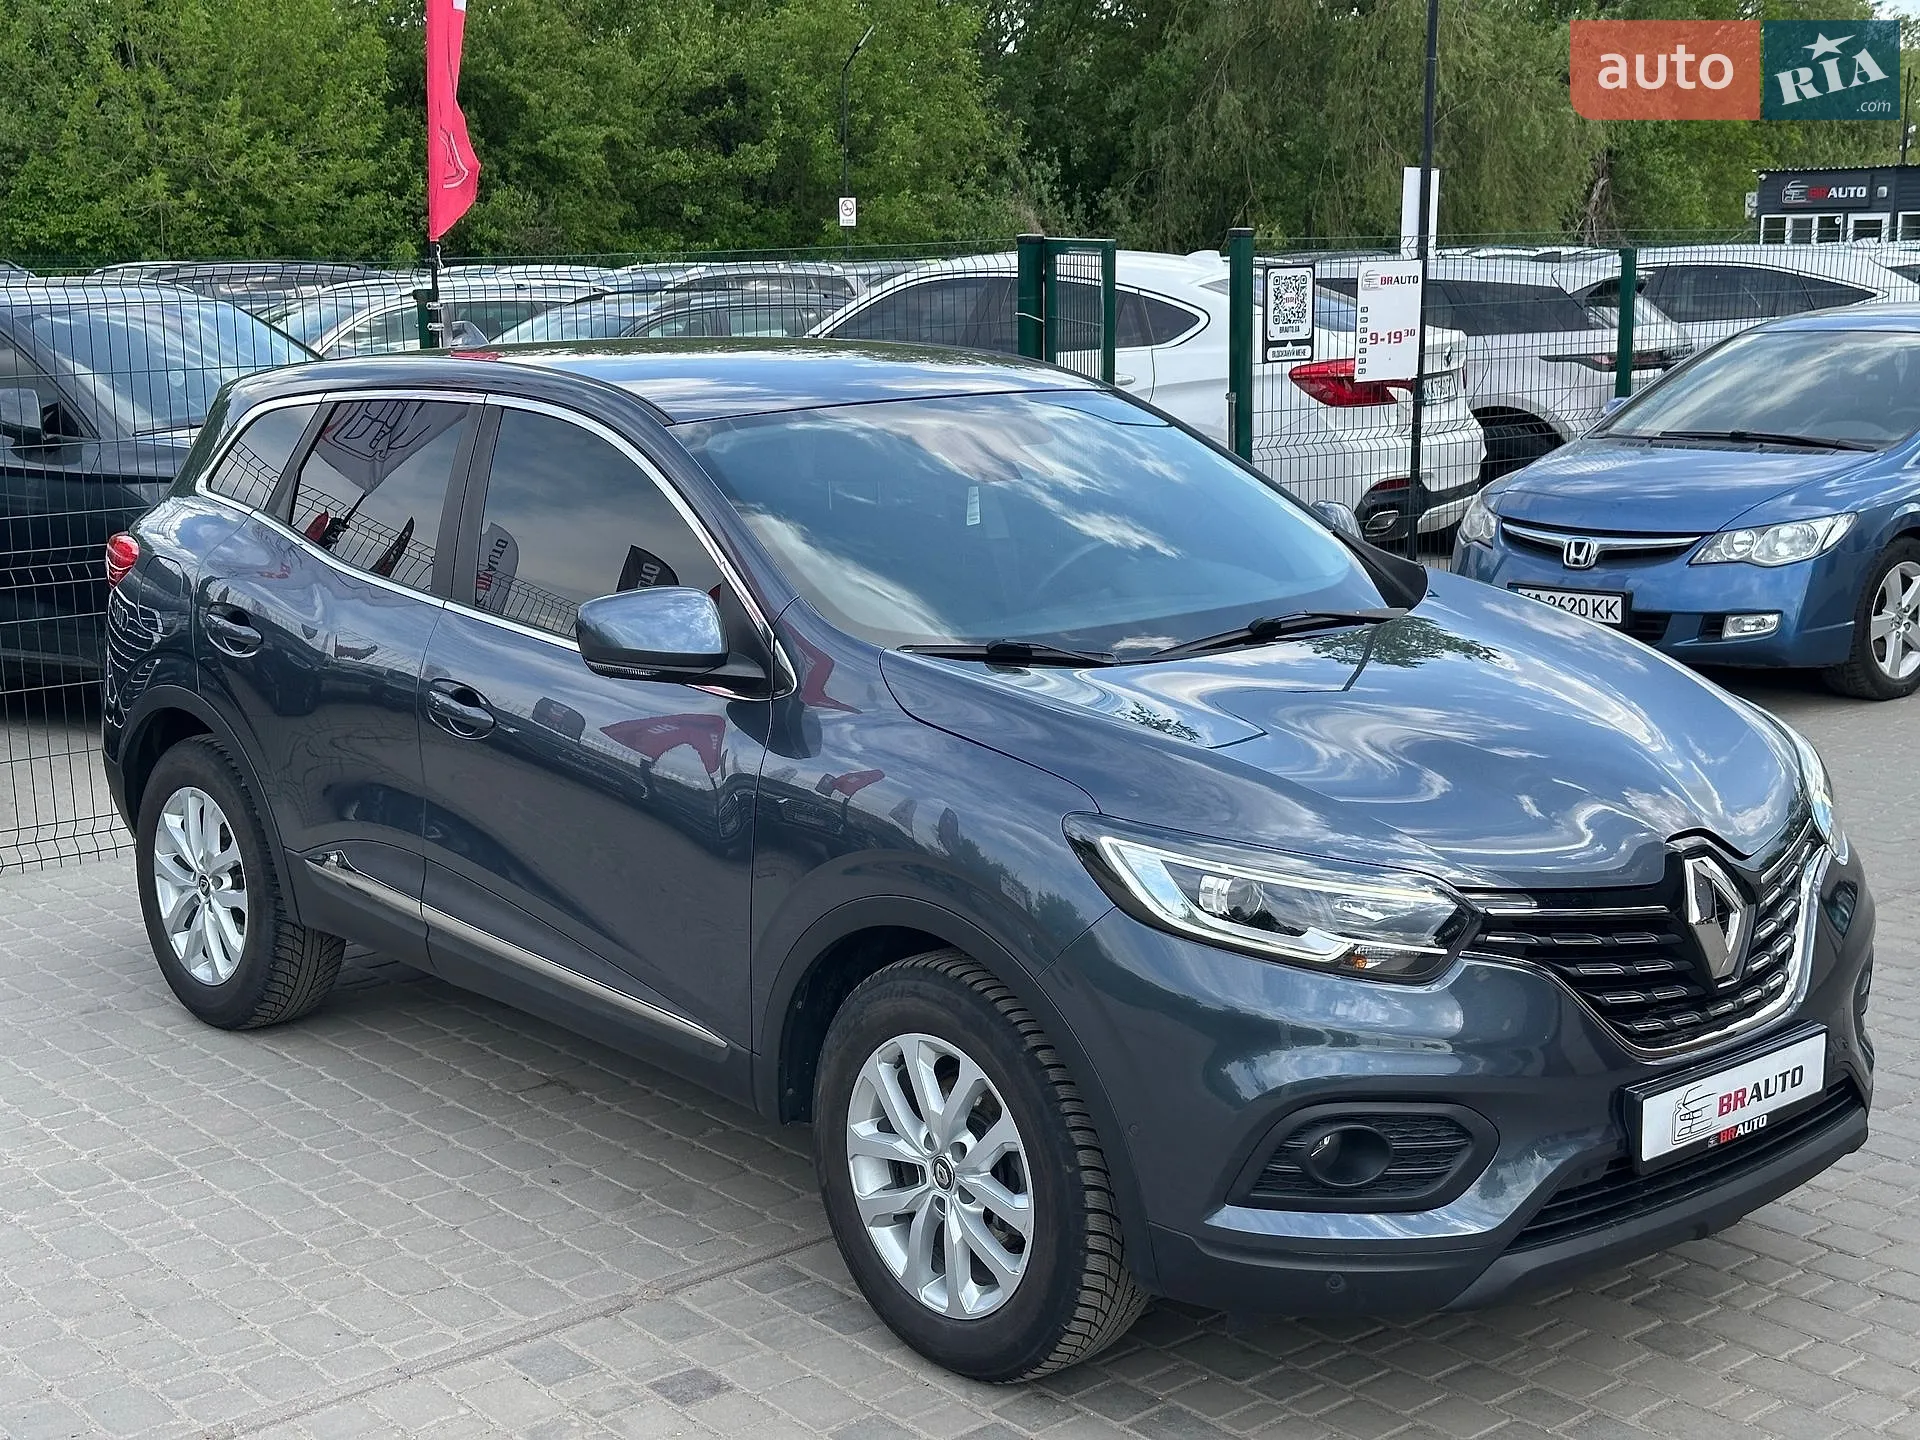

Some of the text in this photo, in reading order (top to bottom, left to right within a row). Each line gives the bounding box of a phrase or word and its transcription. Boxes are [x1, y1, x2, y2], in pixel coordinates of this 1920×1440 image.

[1808, 186, 1867, 199] BRAUTO
[1380, 275, 1419, 286] BRAUTO
[1718, 1064, 1804, 1118] BRAUTO
[1720, 1114, 1768, 1144] BRAUTO
